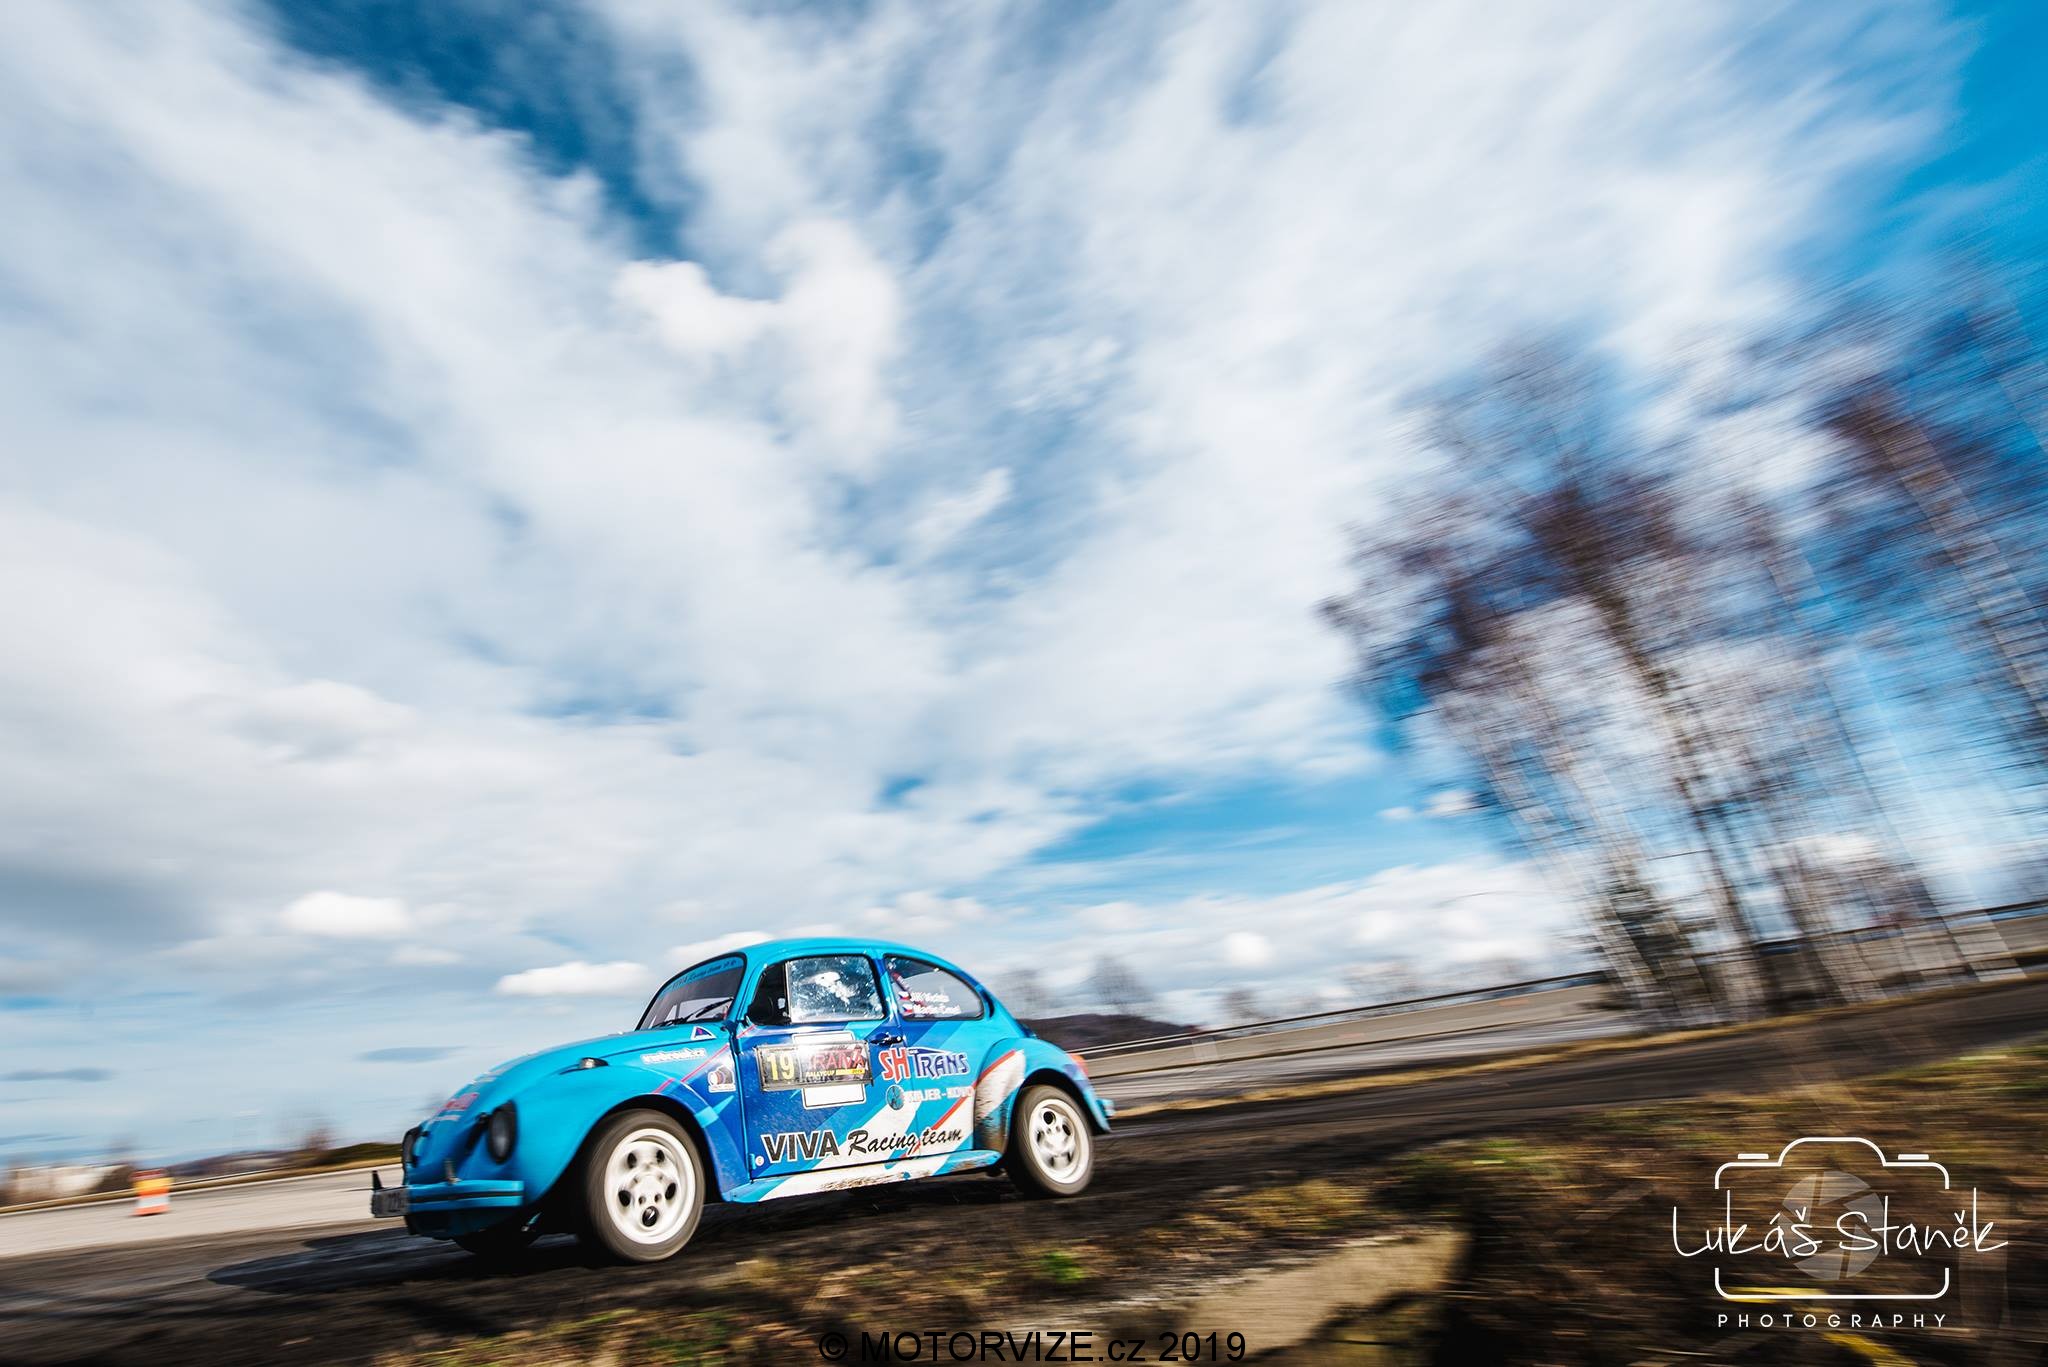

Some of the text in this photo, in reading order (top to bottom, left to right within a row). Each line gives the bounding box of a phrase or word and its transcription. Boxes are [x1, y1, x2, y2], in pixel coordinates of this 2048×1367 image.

[767, 1052, 795, 1080] 19
[763, 1128, 964, 1161] VIVA Racing team
